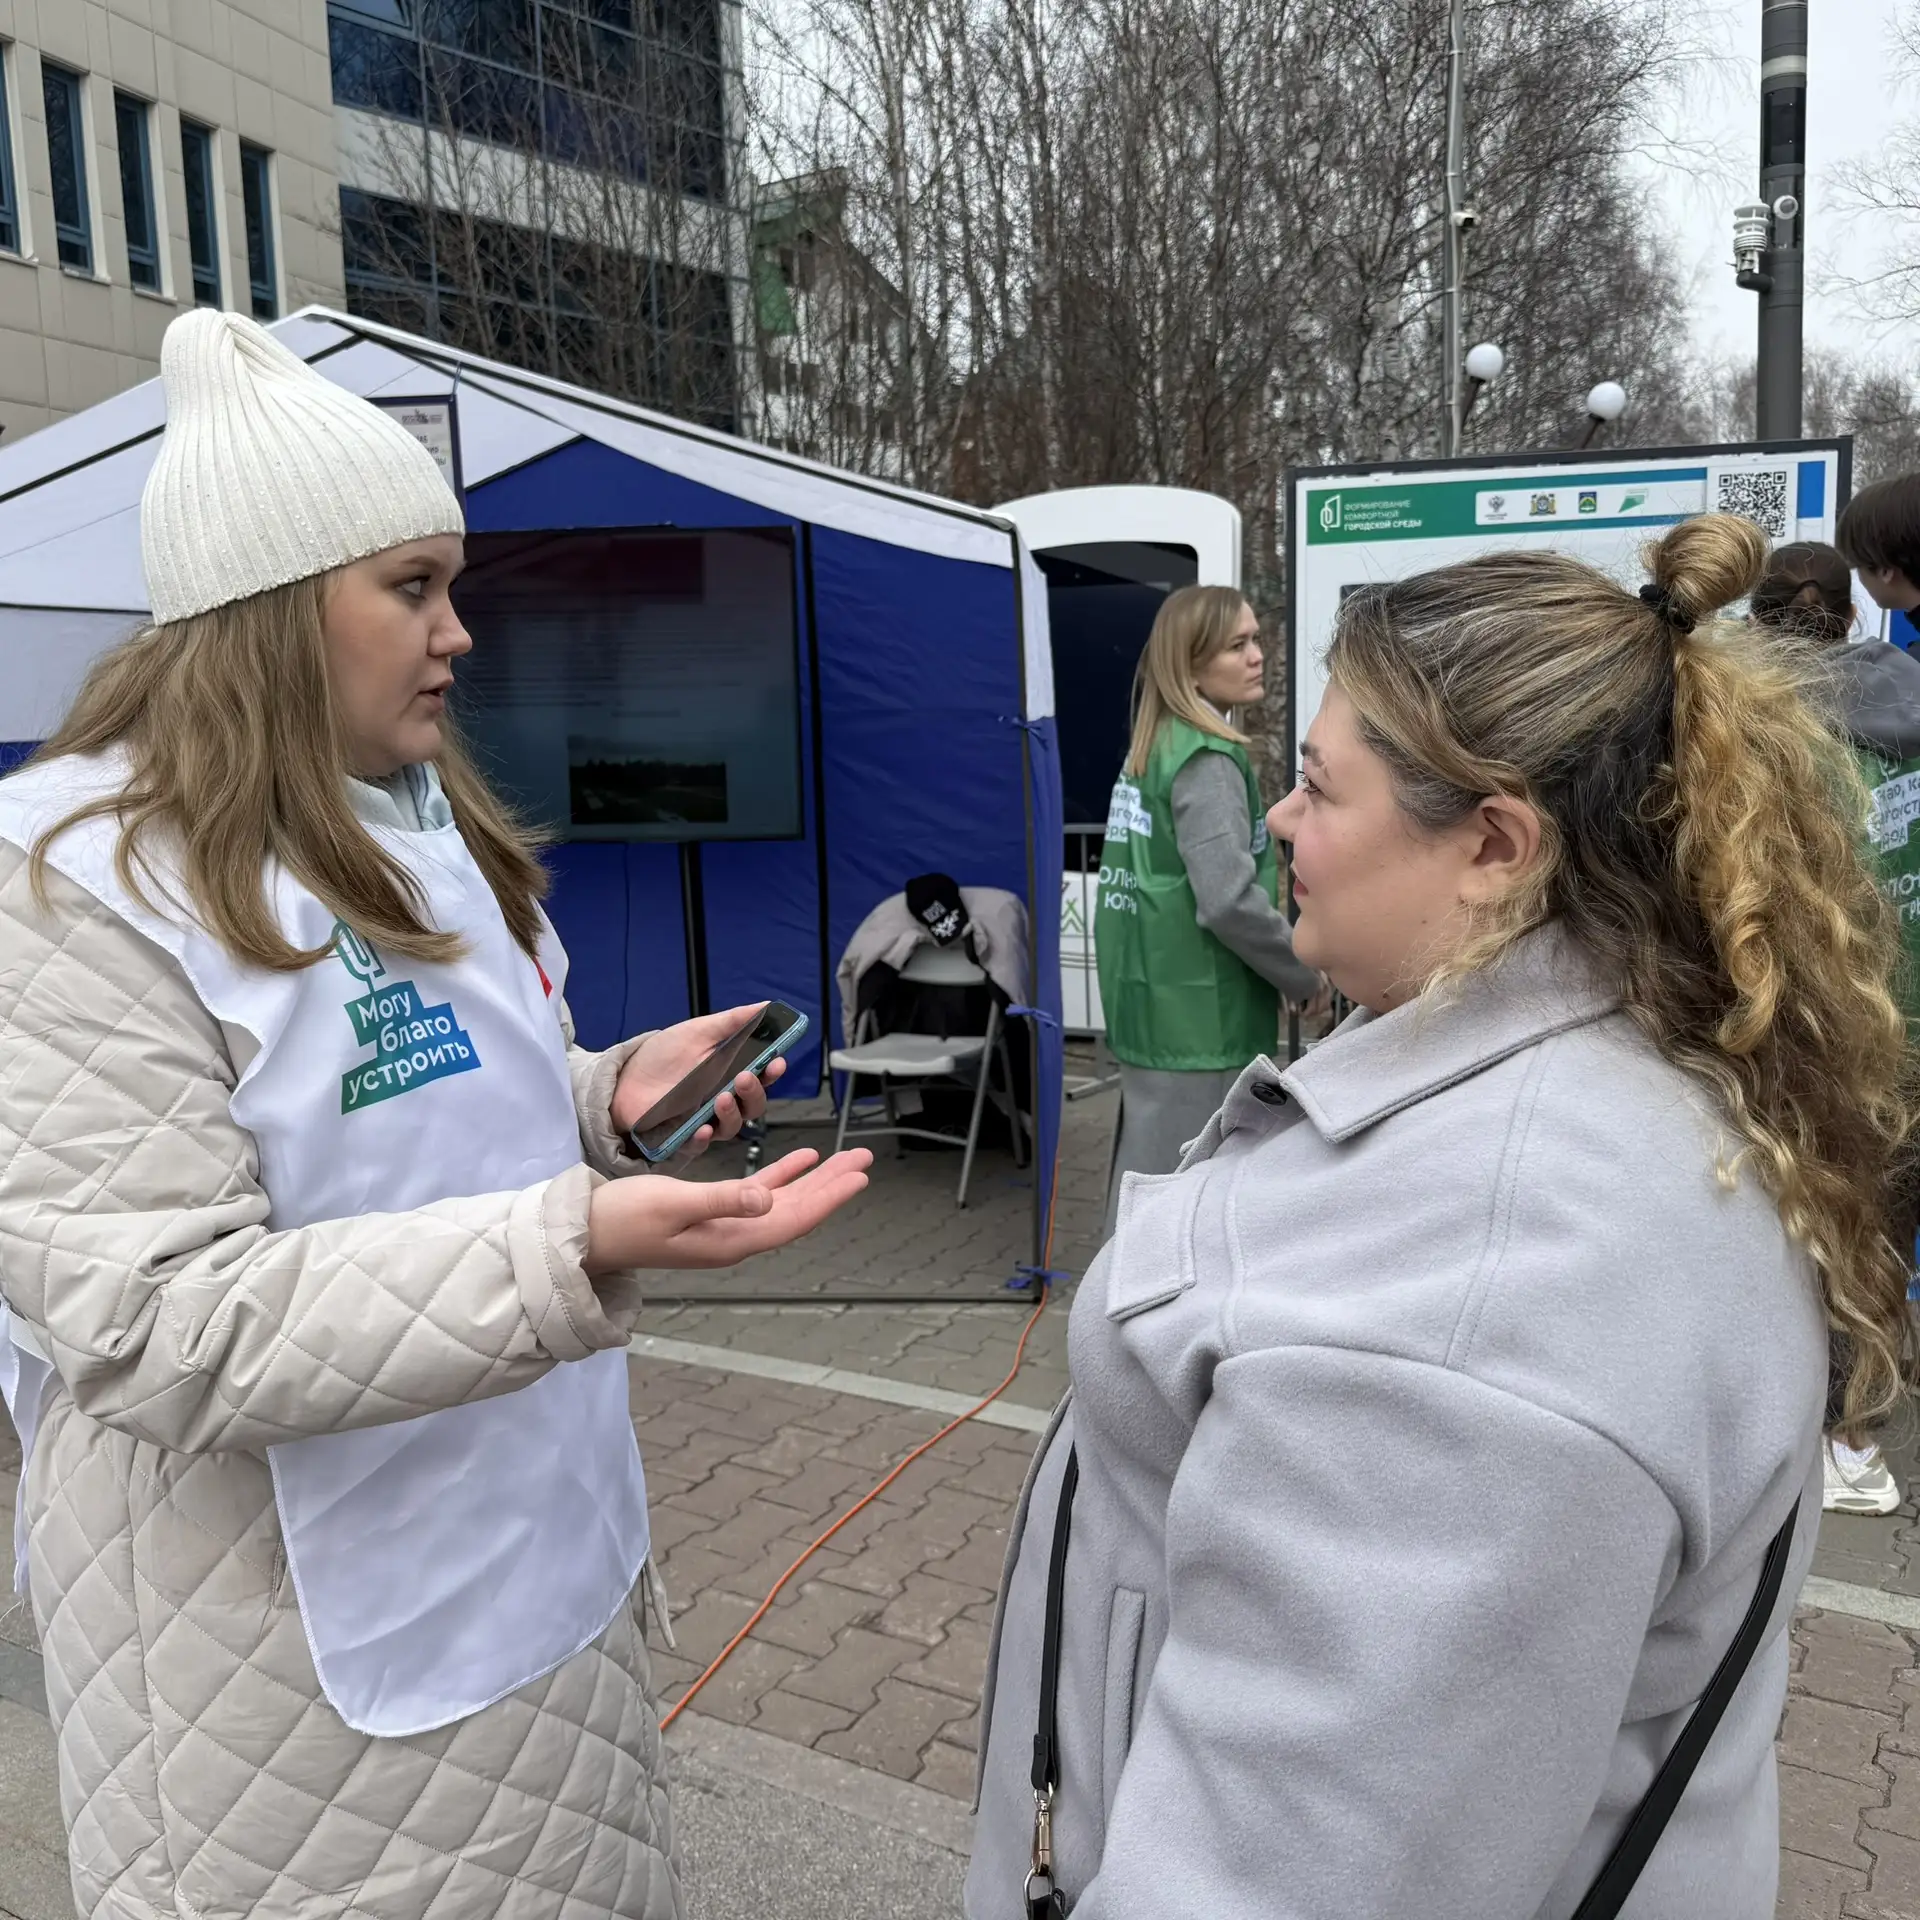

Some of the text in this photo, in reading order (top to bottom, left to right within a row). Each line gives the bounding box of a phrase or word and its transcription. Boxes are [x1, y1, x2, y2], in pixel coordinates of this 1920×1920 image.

[1343, 518, 1423, 532] ГОРОДСКОЙ СРЕДЫ
[356, 991, 411, 1029] Могу
[380, 1016, 451, 1052] благо
[348, 1042, 470, 1105] устроить
